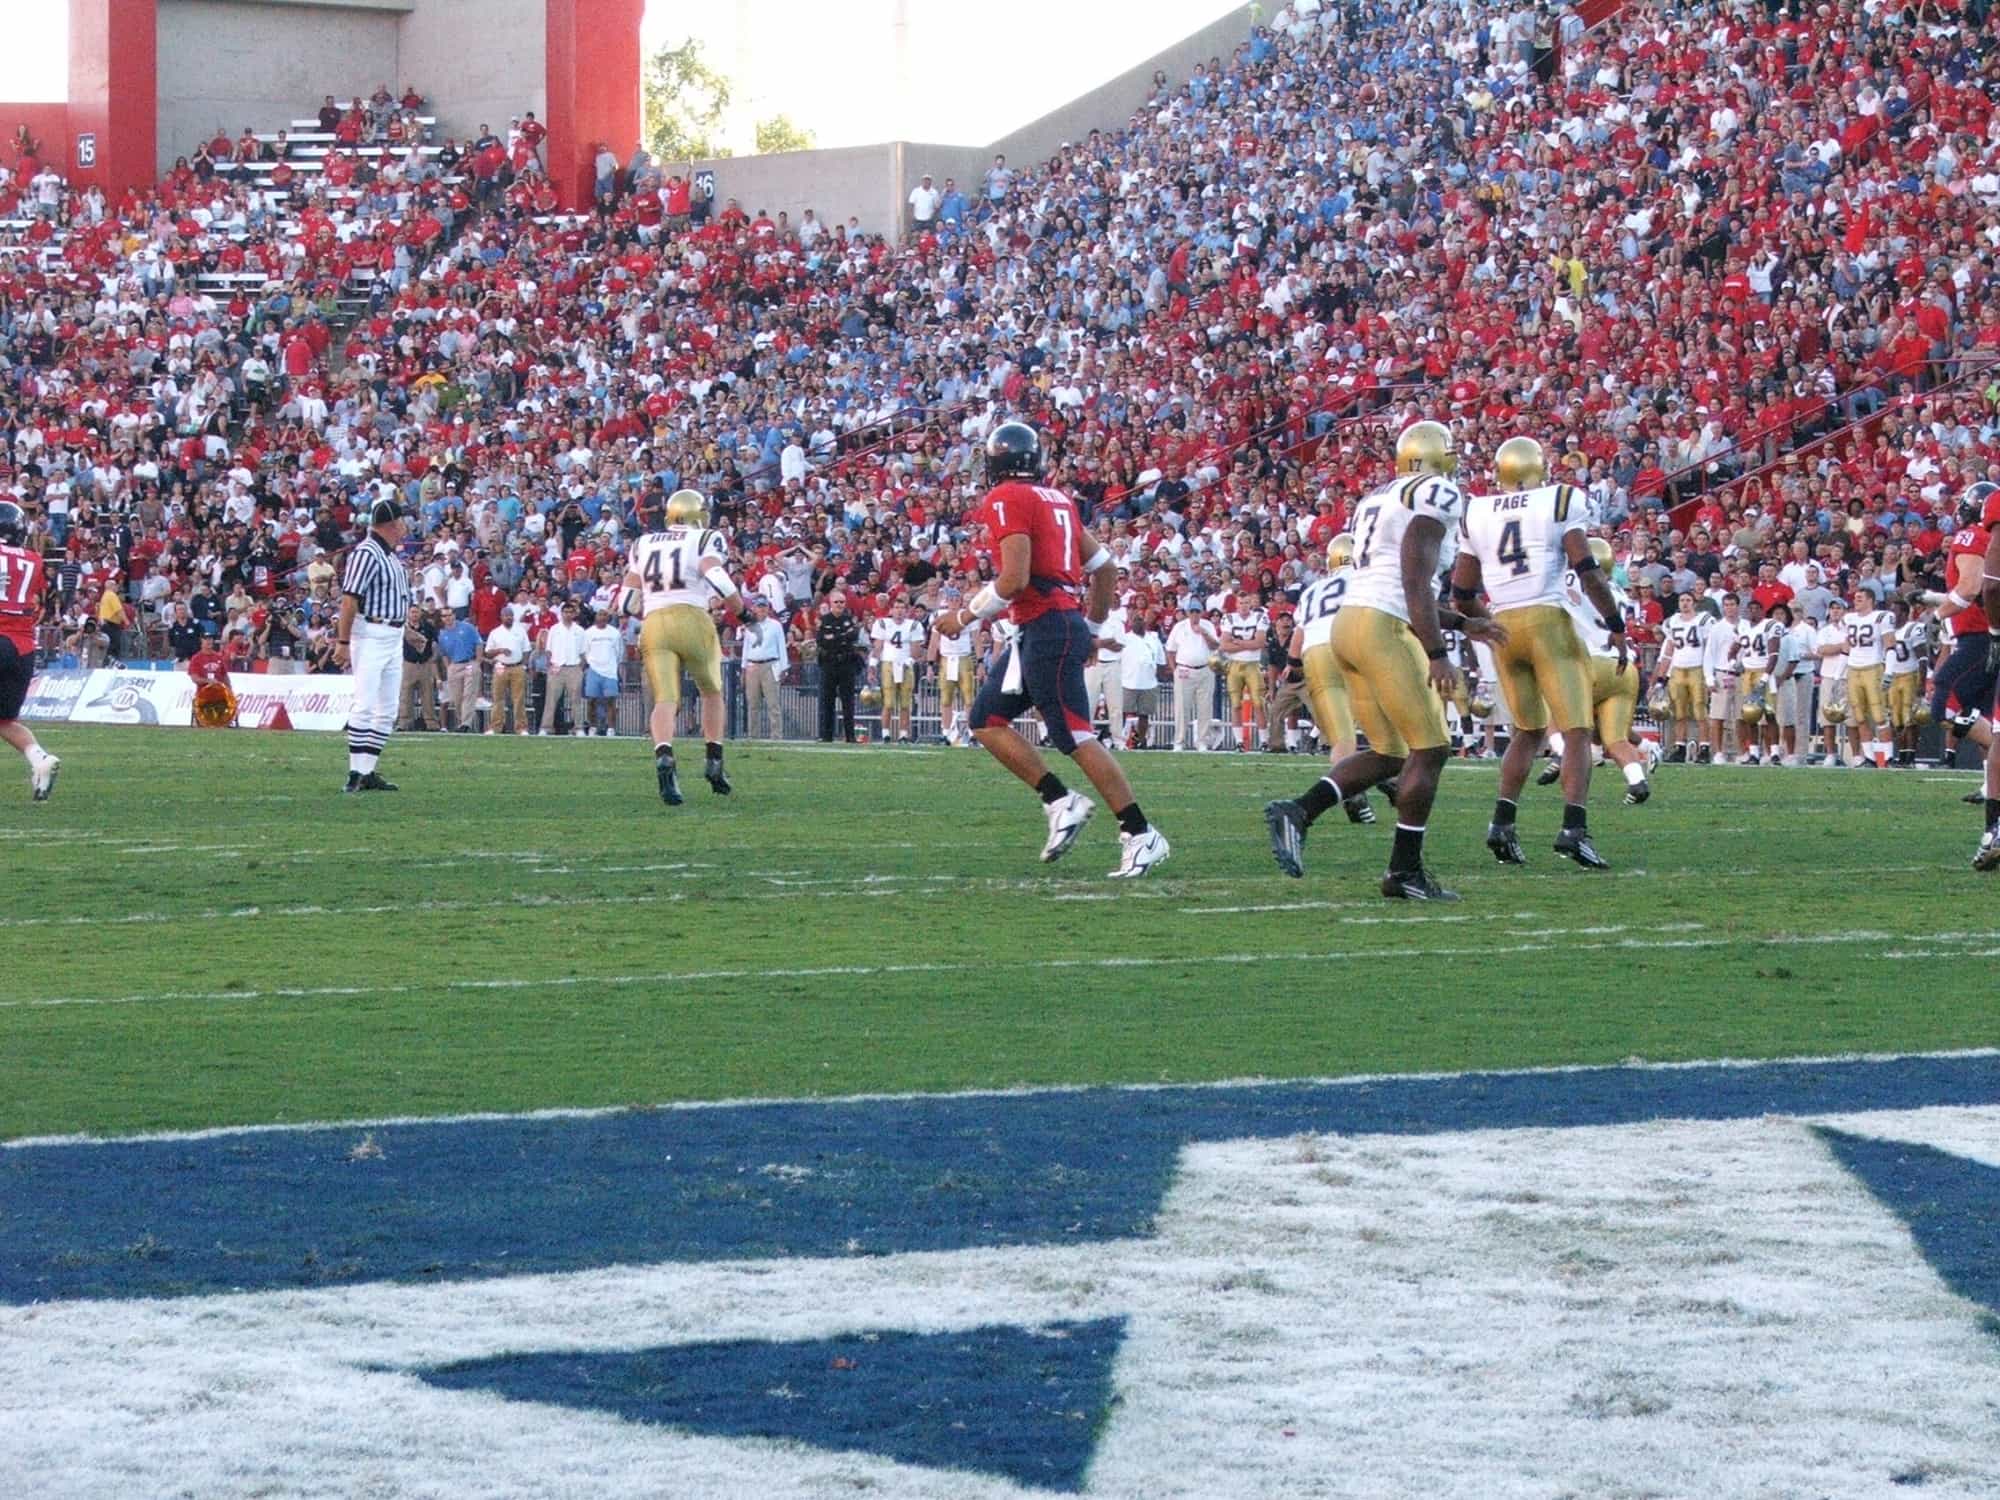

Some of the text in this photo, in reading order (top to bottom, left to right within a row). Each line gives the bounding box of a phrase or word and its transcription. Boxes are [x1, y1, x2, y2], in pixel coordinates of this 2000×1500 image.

[79, 140, 95, 162] 15
[1408, 458, 1422, 472] 17
[1424, 484, 1458, 513] 17
[1493, 494, 1529, 512] PAGE
[993, 502, 1006, 527] 7
[1053, 508, 1072, 571] 7
[1498, 520, 1529, 575] 4
[643, 547, 686, 593] 41
[1303, 578, 1345, 625] 12
[890, 631, 902, 648] 4
[1671, 626, 1701, 650] 54
[1740, 634, 1767, 657] 24
